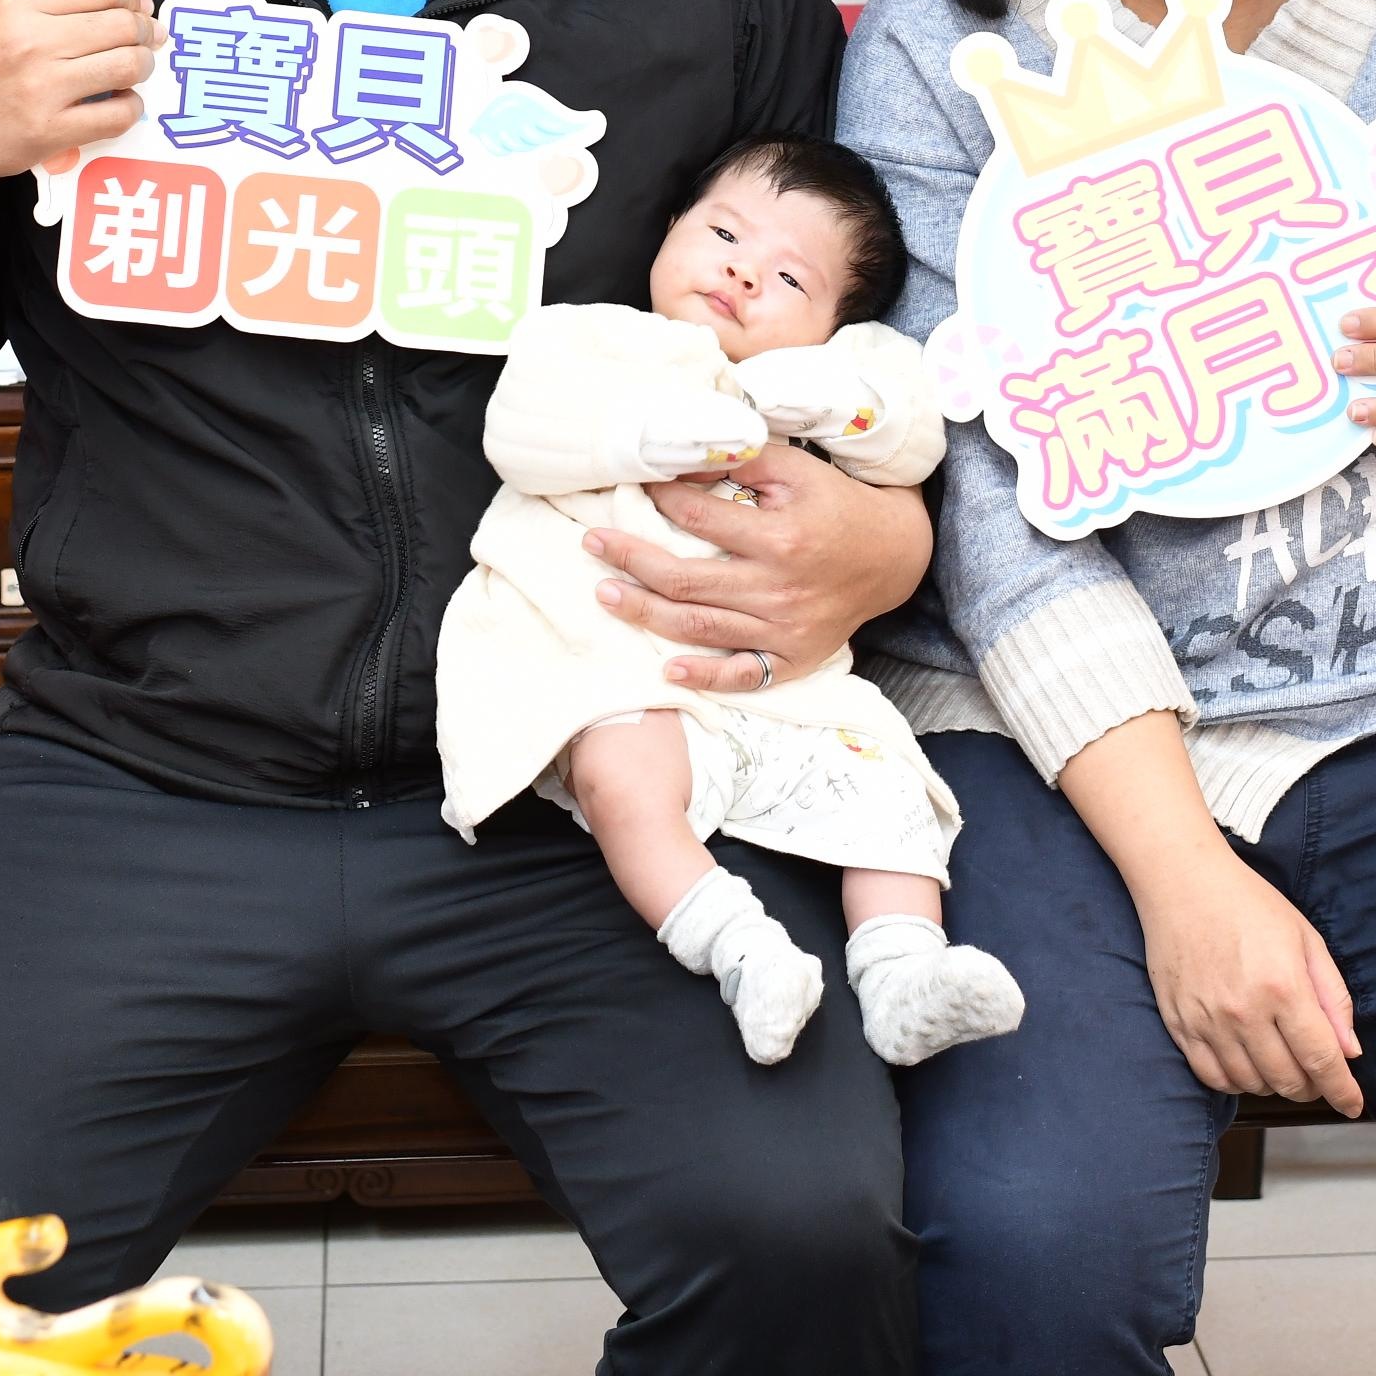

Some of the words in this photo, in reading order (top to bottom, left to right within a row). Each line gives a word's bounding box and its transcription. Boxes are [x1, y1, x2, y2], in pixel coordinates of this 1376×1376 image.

[158, 4, 464, 175] 寶貝
[84, 176, 521, 324] 剃光頭
[1013, 103, 1348, 338] 寶貝
